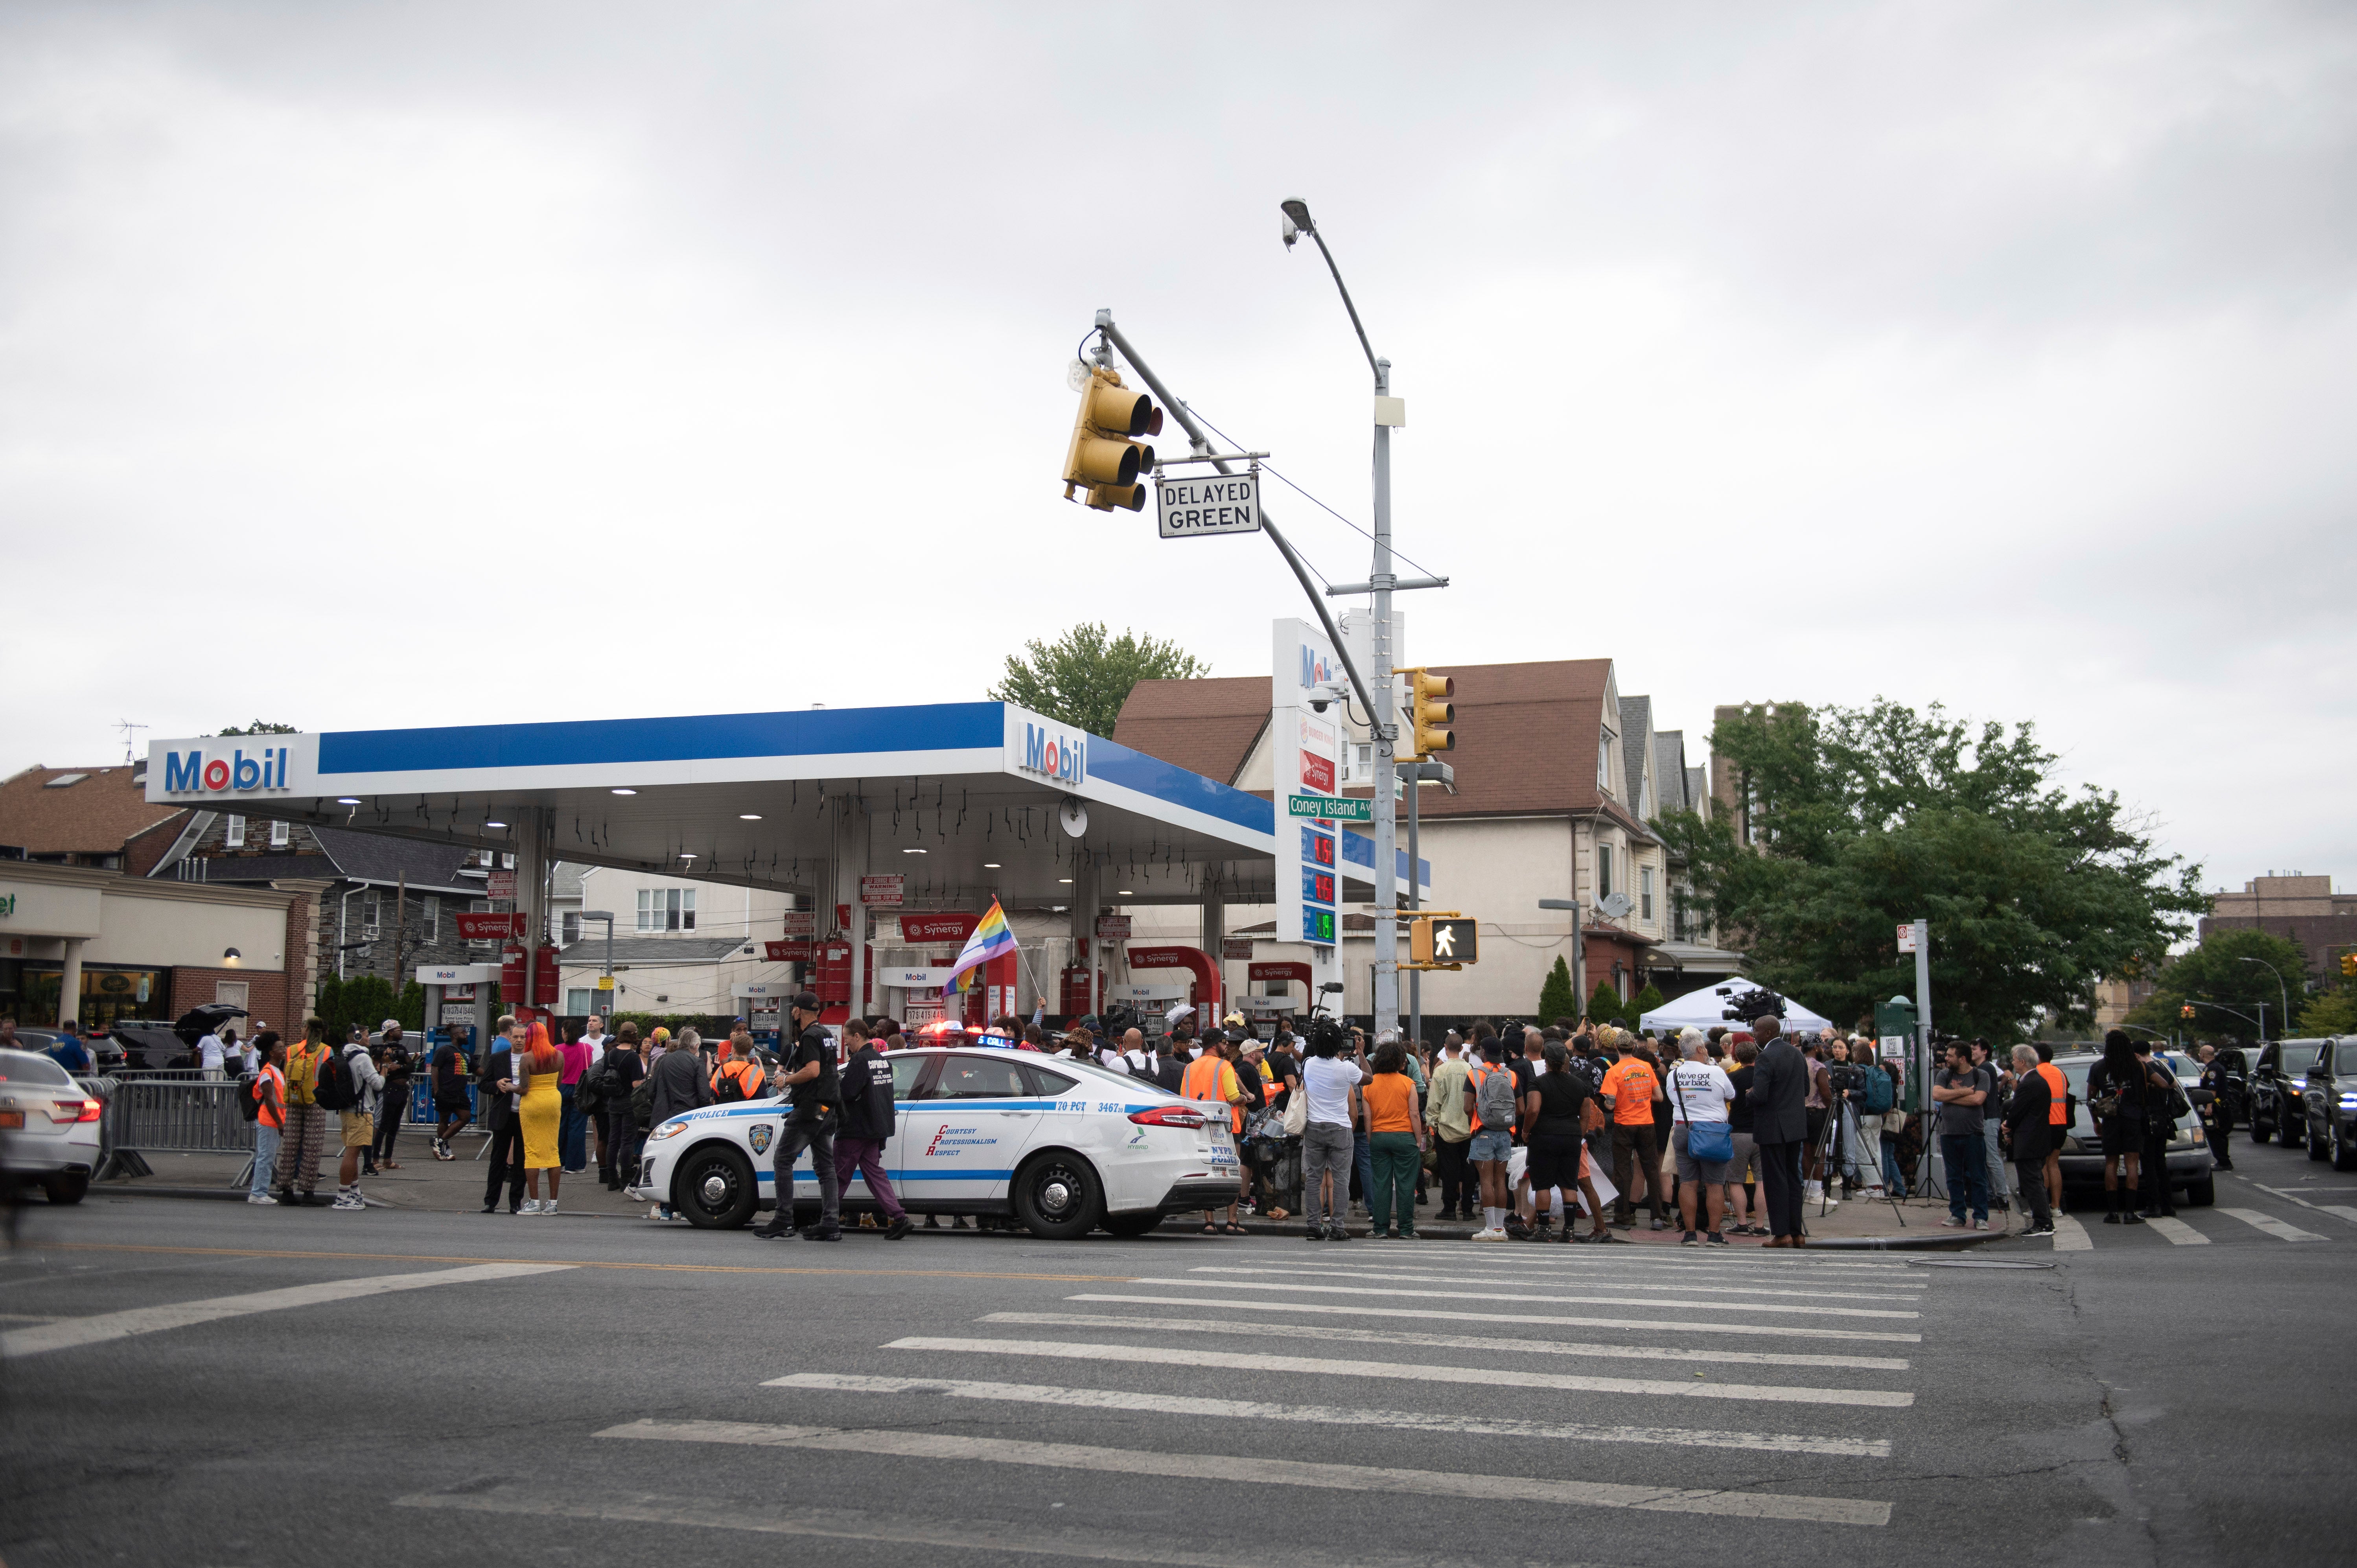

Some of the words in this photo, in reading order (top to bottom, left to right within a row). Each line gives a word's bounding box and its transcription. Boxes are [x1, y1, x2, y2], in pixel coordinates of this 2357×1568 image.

[1166, 483, 1250, 506] DELAYED
[1169, 506, 1250, 528] GREEN
[1309, 726, 1324, 742] BURGER
[1324, 734, 1333, 746] KING
[1026, 722, 1084, 784] Mobil
[165, 748, 288, 791] Mobil
[1312, 765, 1328, 786] Synergy
[1291, 797, 1321, 817] Coney
[1325, 799, 1356, 816] Island
[1360, 802, 1371, 811] Av
[924, 925, 963, 935] Synergy
[451, 1007, 459, 1015] 375
[909, 1011, 919, 1019] 375
[921, 1010, 930, 1019] 415
[933, 1010, 943, 1019] 445
[987, 1037, 1006, 1047] CALL
[1057, 1102, 1067, 1111] 70
[1070, 1102, 1086, 1111] PCT
[692, 1110, 729, 1120] POLICE
[939, 1124, 977, 1134] COURTESY
[932, 1135, 997, 1145] PROFESSIONALISM
[925, 1146, 960, 1156] RESPECT
[1211, 1147, 1232, 1155] NYPD
[1210, 1156, 1237, 1164] POLICE
